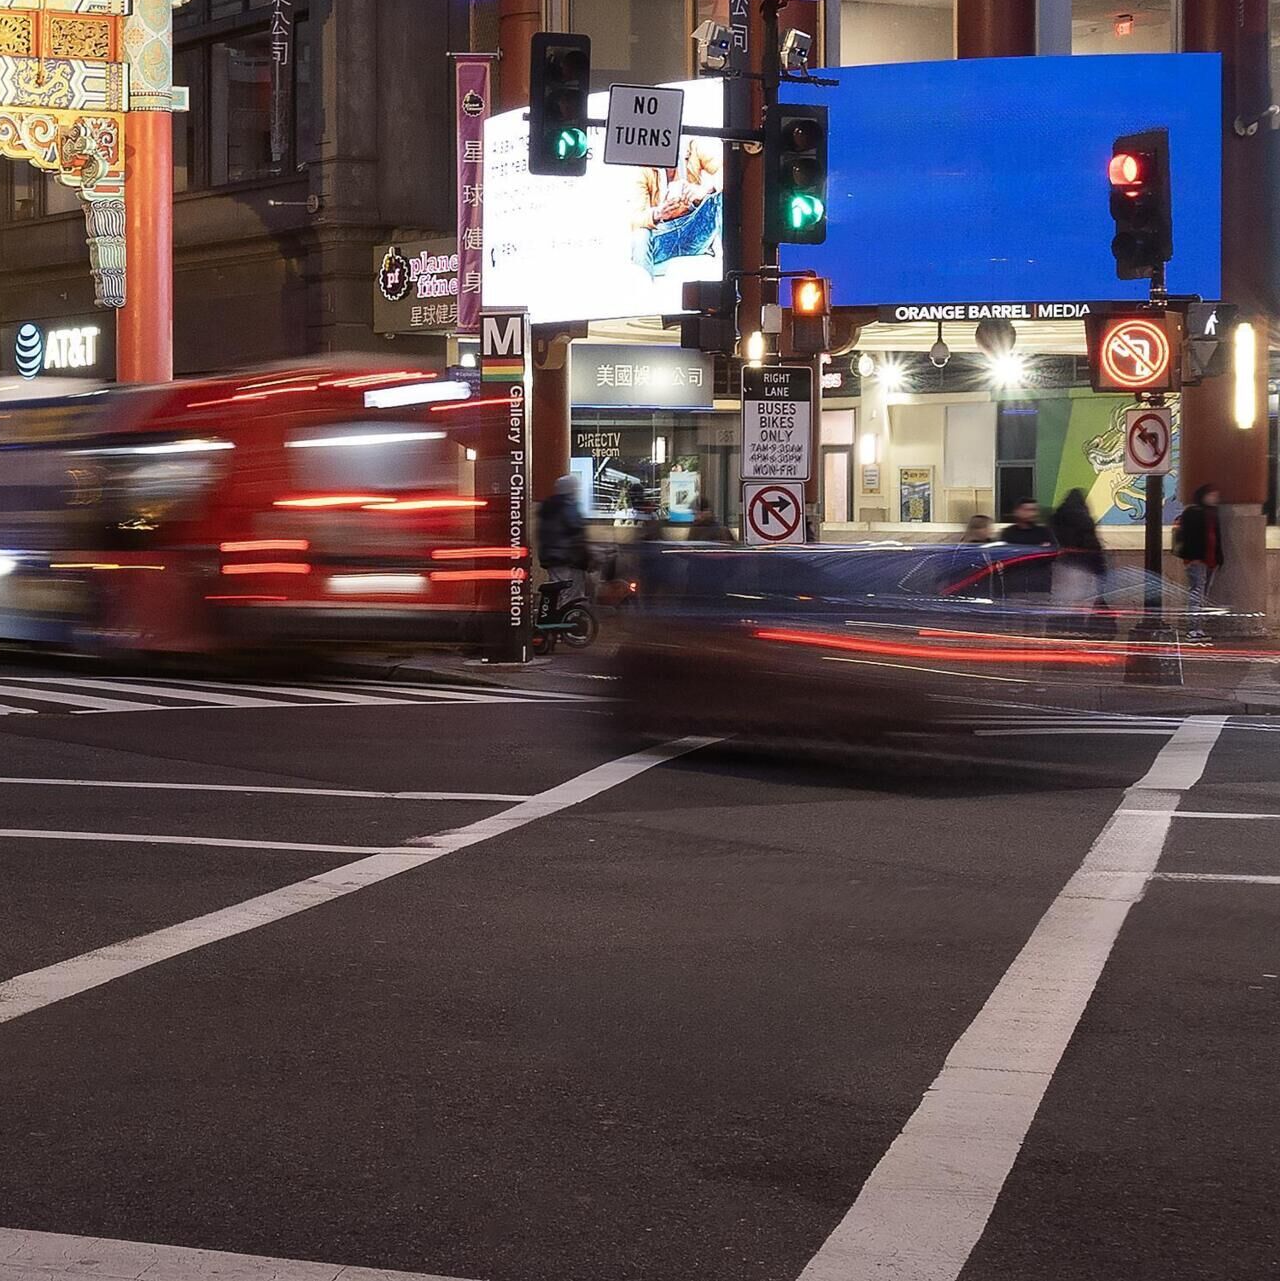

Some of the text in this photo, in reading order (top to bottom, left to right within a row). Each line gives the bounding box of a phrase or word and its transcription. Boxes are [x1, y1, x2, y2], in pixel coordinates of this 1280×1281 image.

[633, 96, 658, 115] NO
[615, 126, 671, 147] TURNS
[462, 139, 484, 295] 星球健身
[409, 250, 458, 282] plane
[386, 268, 400, 289] pf
[416, 274, 458, 298] fitne
[410, 304, 458, 327] 星球健身
[895, 303, 1091, 320] ORANGE BARREL MEDIA
[483, 317, 522, 355] M
[44, 326, 98, 369] AT&T
[597, 364, 703, 387] 美國娛公司
[763, 373, 791, 383] RIGHT
[764, 387, 790, 397] LANE
[758, 402, 796, 415] BUSES
[760, 416, 794, 429] BIKES
[577, 432, 621, 448] DIRECTV
[761, 430, 793, 442] ONLY
[591, 447, 620, 458] stream
[753, 464, 797, 476] MON-FRI
[509, 385, 524, 626] Gallery Pl-Chinatown Station
